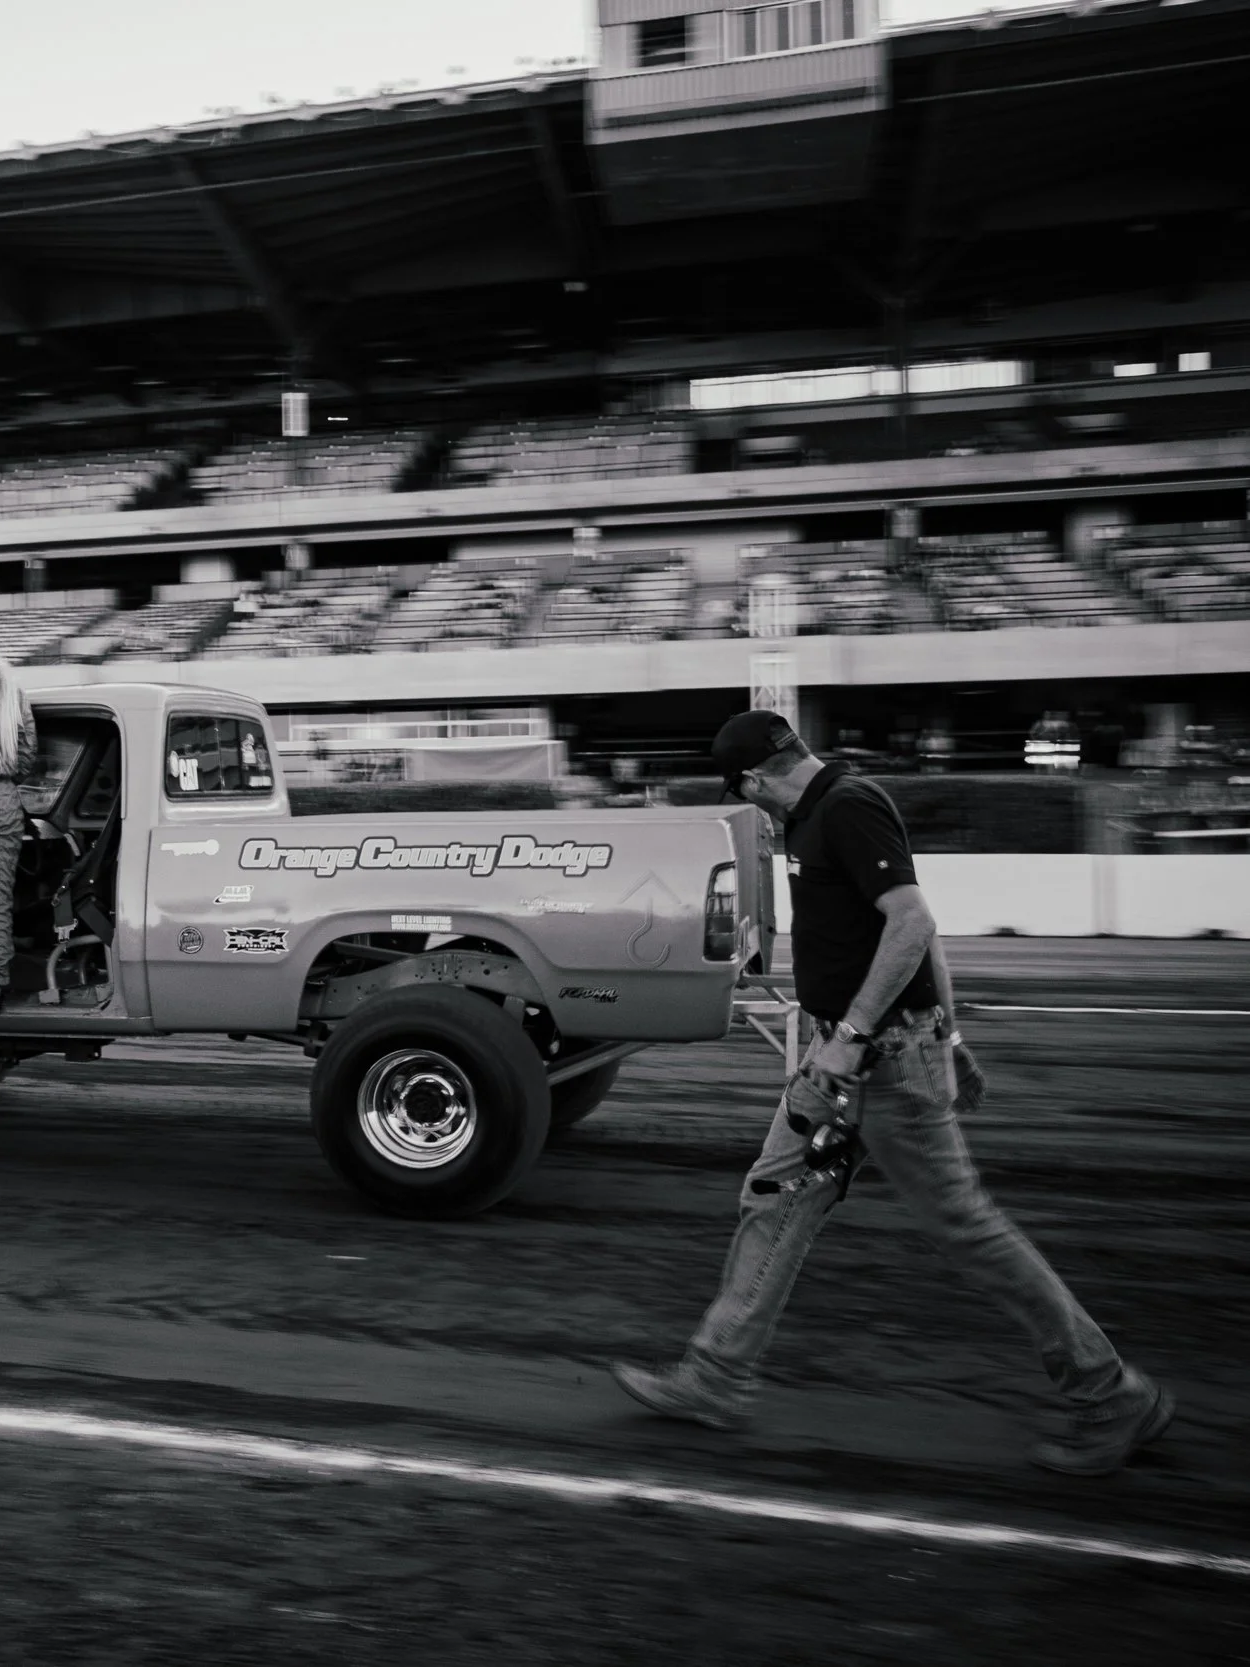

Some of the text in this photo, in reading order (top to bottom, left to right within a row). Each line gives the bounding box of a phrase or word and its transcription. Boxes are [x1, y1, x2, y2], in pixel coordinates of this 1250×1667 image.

[239, 835, 612, 877] Orange Country Dodge
